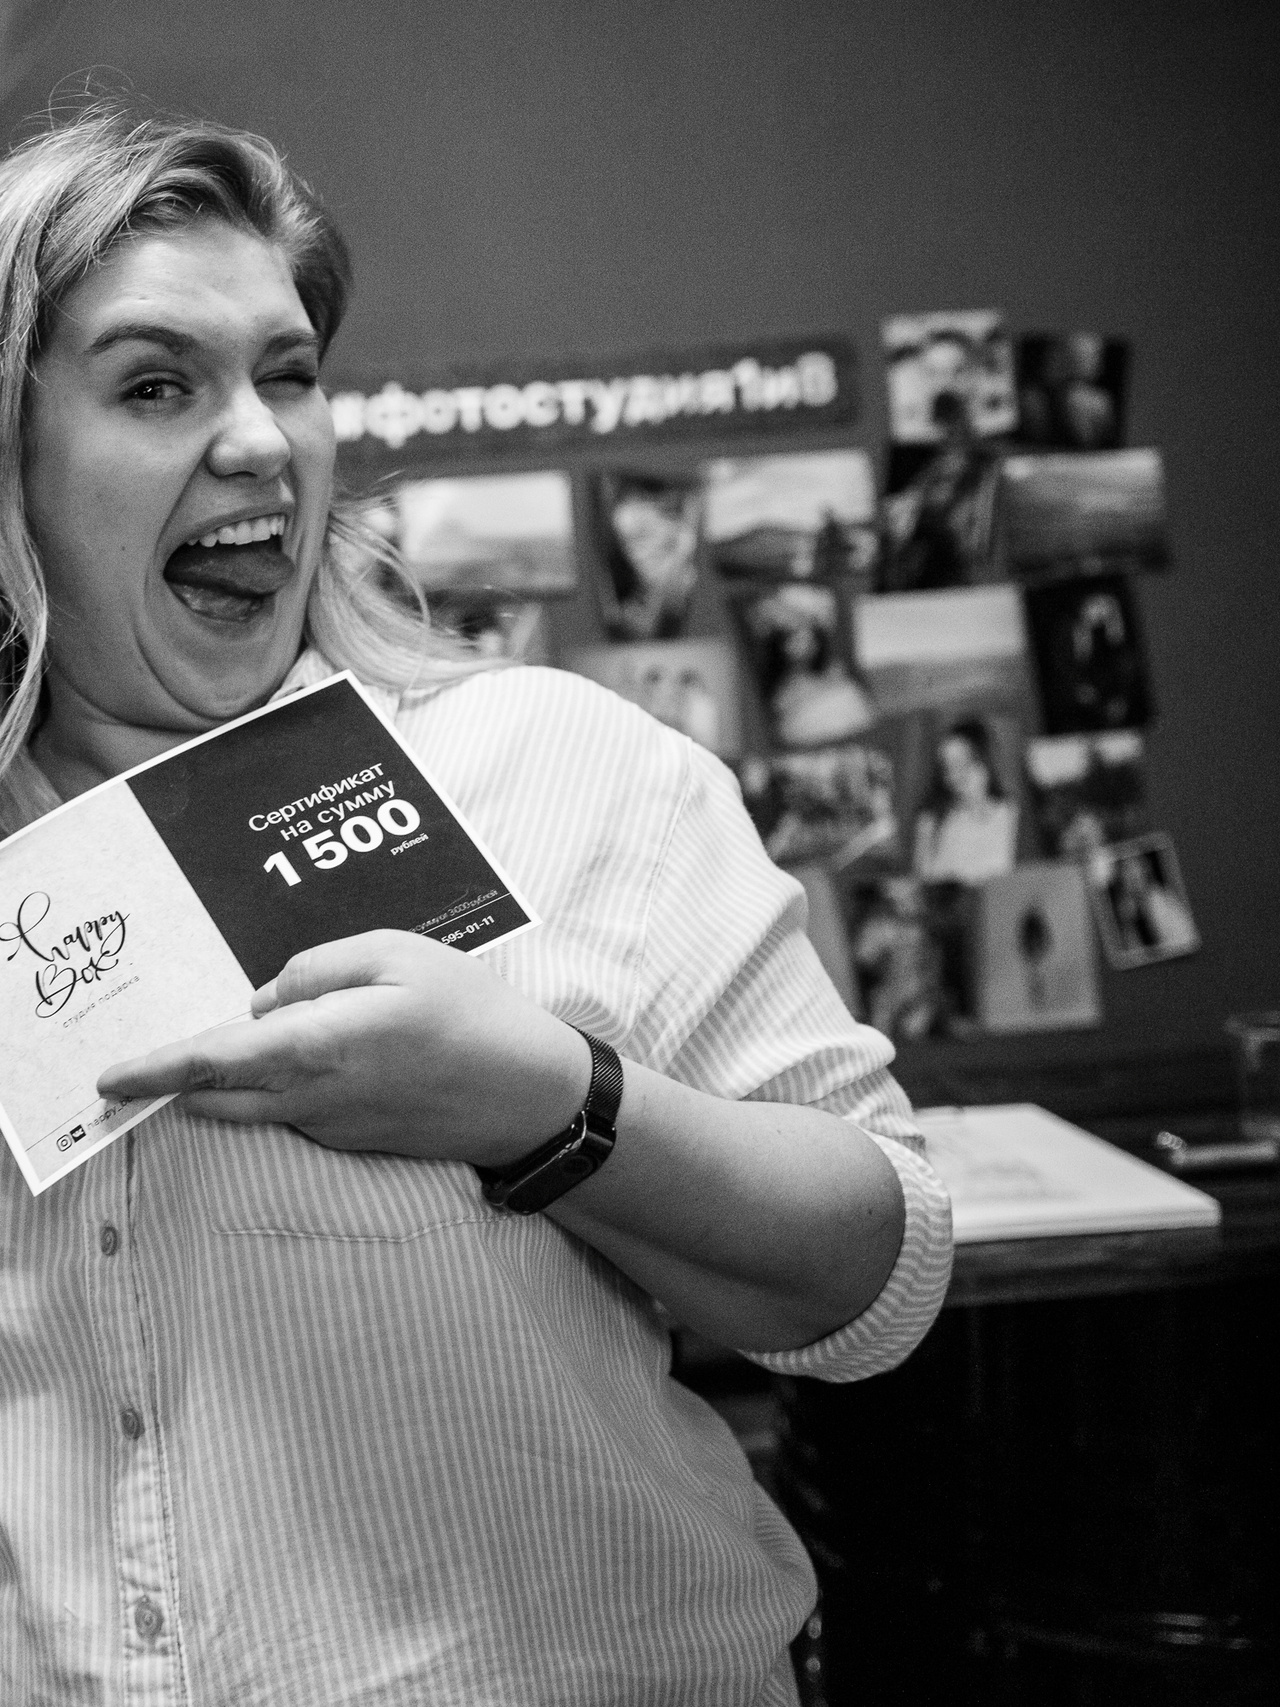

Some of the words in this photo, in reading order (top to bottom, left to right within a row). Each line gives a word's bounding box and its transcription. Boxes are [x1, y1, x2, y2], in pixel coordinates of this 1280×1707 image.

[248, 762, 384, 832] Сертификат
[279, 819, 314, 842] на
[317, 780, 396, 824] сумму
[390, 832, 430, 856] рублей
[441, 915, 496, 946] 595-01-11
[63, 1002, 97, 1029] студия
[98, 975, 140, 1004] подарка
